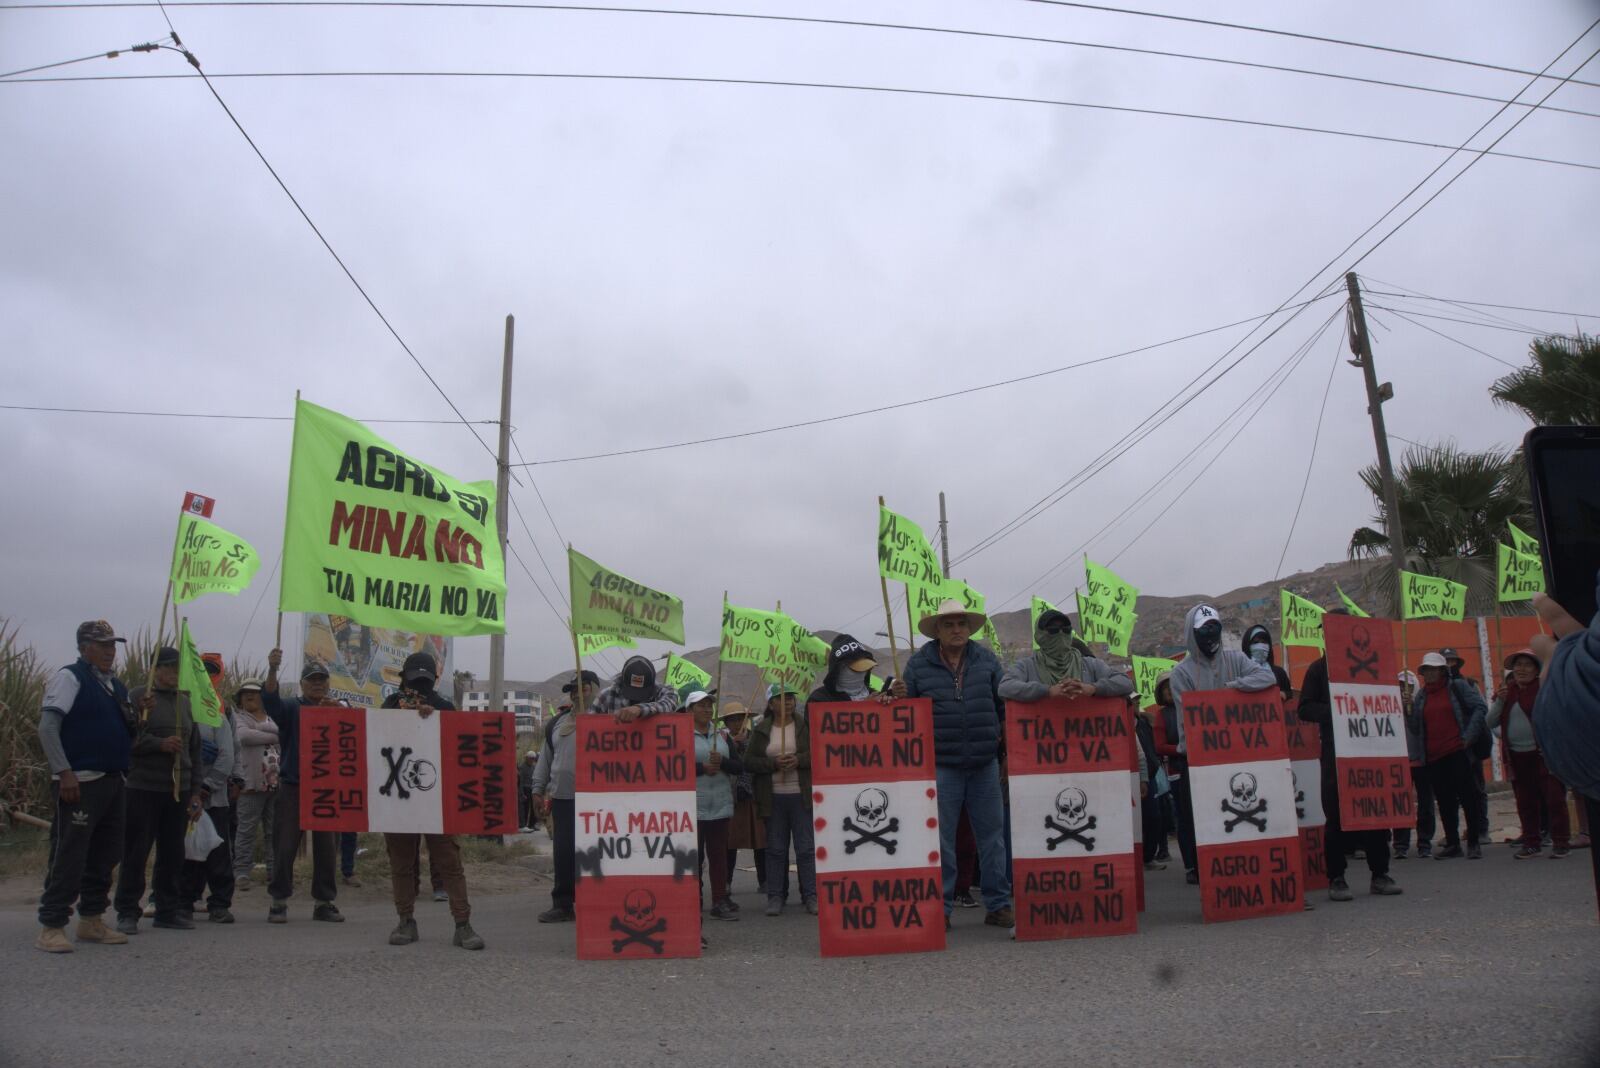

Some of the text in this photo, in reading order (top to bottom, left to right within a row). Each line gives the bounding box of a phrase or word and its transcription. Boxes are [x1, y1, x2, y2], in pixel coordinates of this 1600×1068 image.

[335, 440, 488, 527] AGRO SI
[182, 521, 222, 555] Agro
[329, 500, 486, 570] MINA NO
[177, 552, 240, 579] Mina No
[878, 544, 941, 587] Mina No
[1504, 549, 1543, 577] Agro
[322, 568, 498, 621] TIA MARIA NO VA
[1408, 575, 1439, 599] Agro
[1502, 574, 1541, 594] Mina
[589, 590, 670, 623] MINA NO
[1105, 602, 1122, 625] No
[1286, 595, 1318, 623] Agro
[1440, 601, 1458, 617] No
[722, 608, 760, 637] Agro
[1284, 620, 1320, 640] Mina
[721, 634, 787, 665] Mina No
[1106, 627, 1121, 647] No
[1225, 702, 1281, 724] MARIA
[1363, 693, 1402, 715] MARIA
[820, 705, 915, 734] AGRO SI
[1064, 715, 1128, 739] MARIA
[585, 724, 677, 753] AGRO SI
[311, 725, 331, 780] MINA
[338, 720, 363, 811] AGRO SI
[825, 744, 882, 768] MINA
[590, 761, 646, 784] MINA
[1348, 765, 1404, 788] AGRO SI
[481, 763, 504, 831] MARIA
[1352, 797, 1388, 817] MINA
[628, 811, 695, 834] MARIA
[1210, 847, 1288, 878] AGRO SI
[872, 878, 941, 903] MARIA
[1025, 863, 1114, 894] AGRO SI
[1215, 884, 1265, 909] MINA
[1029, 902, 1085, 926] MINA
